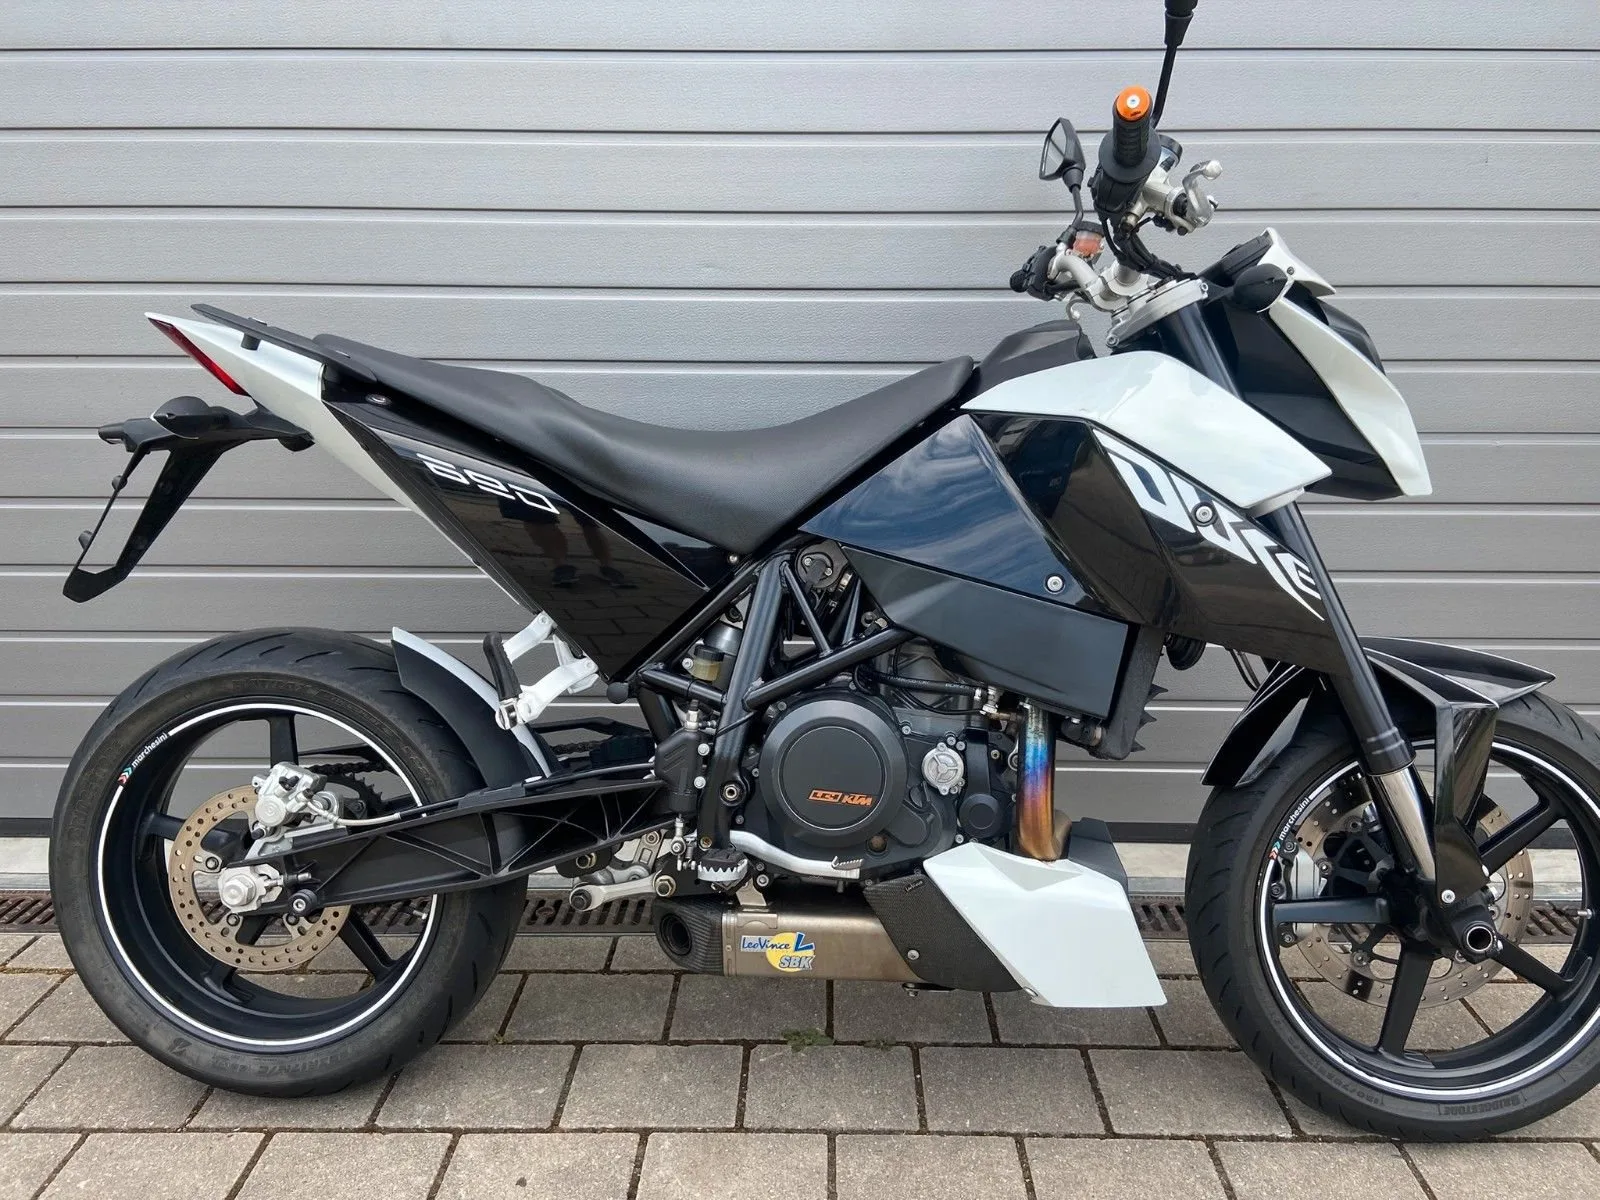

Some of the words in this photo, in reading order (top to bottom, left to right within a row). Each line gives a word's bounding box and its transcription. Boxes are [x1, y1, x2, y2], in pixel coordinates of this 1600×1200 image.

[416, 452, 561, 515] 690
[1092, 428, 1325, 622] DUKE
[131, 732, 168, 768] marchesini
[842, 793, 873, 806] KTM
[1279, 797, 1310, 841] marchesini
[742, 937, 791, 950] LeoVince
[779, 955, 815, 970] SBK
